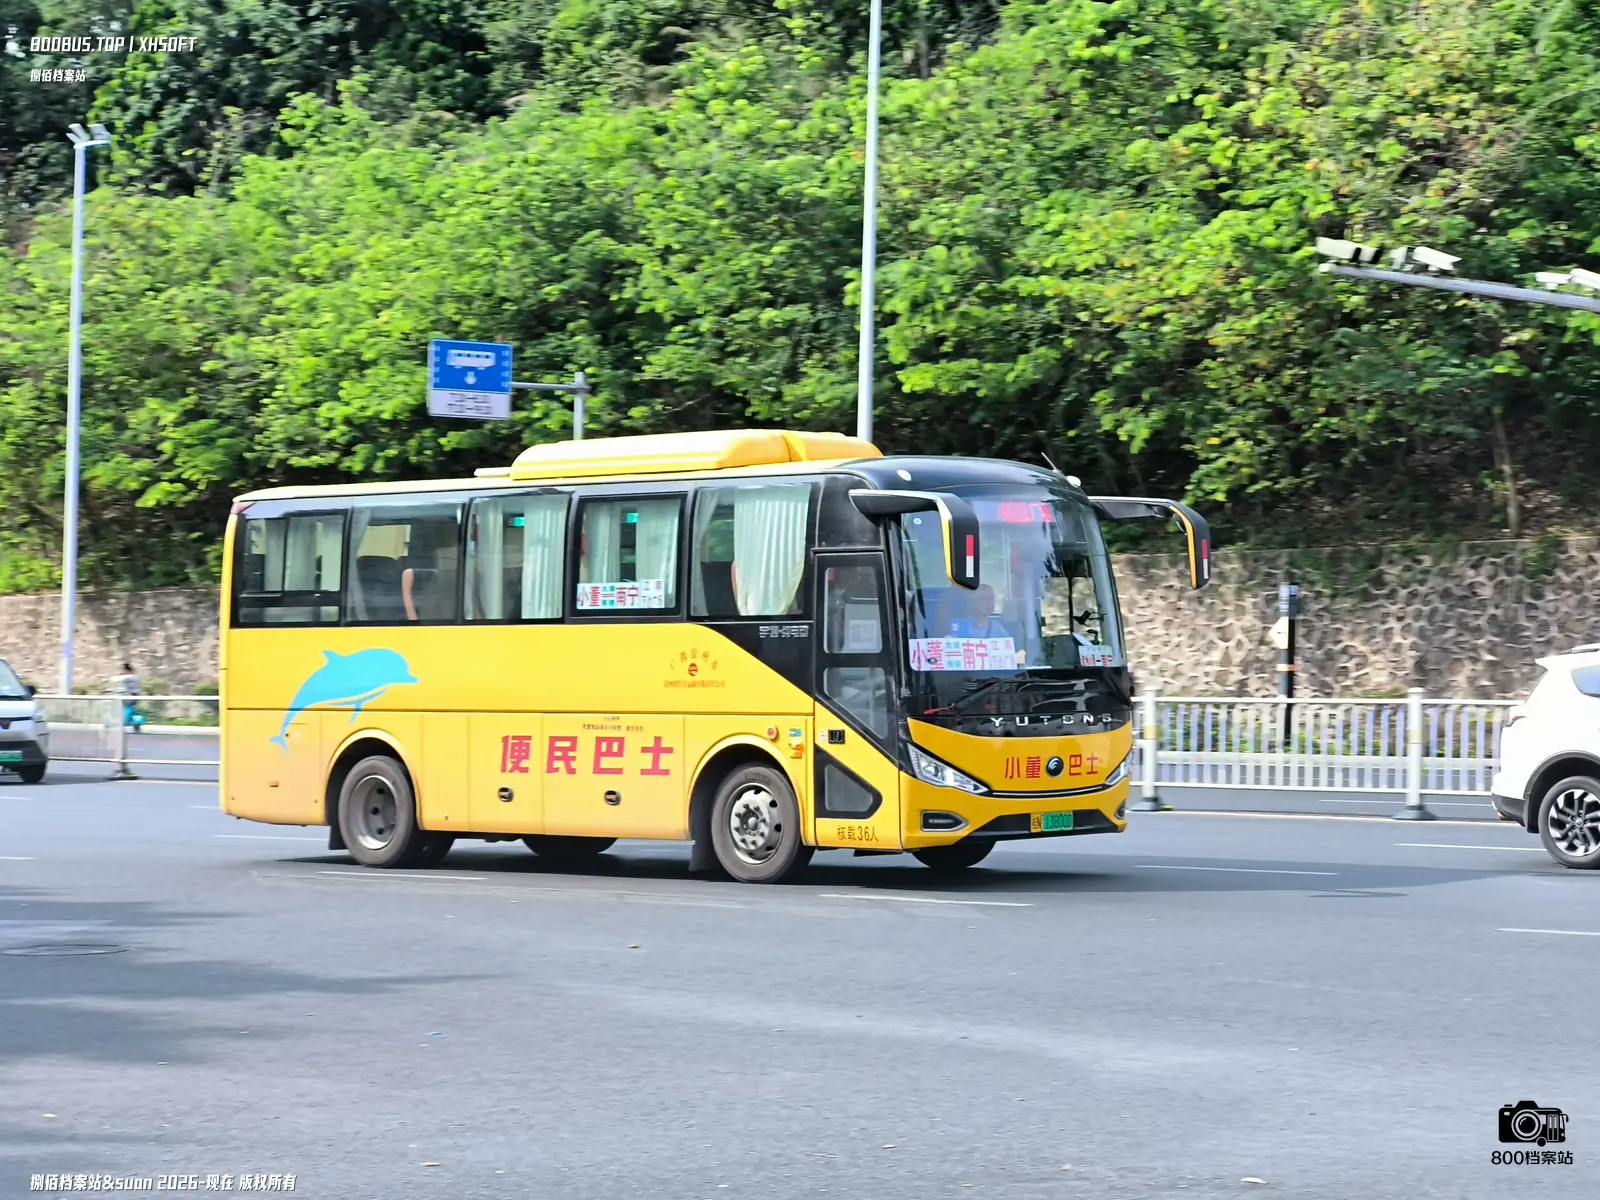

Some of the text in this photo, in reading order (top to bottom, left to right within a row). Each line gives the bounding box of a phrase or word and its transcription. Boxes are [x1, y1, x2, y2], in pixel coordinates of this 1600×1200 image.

[912, 640, 944, 671] 小董
[962, 640, 988, 671] 南宁
[990, 713, 1112, 727] YUTONG
[500, 734, 674, 776] 便民巴士
[1004, 753, 1099, 779] 小董 巴士
[837, 825, 879, 842] 核载36人
